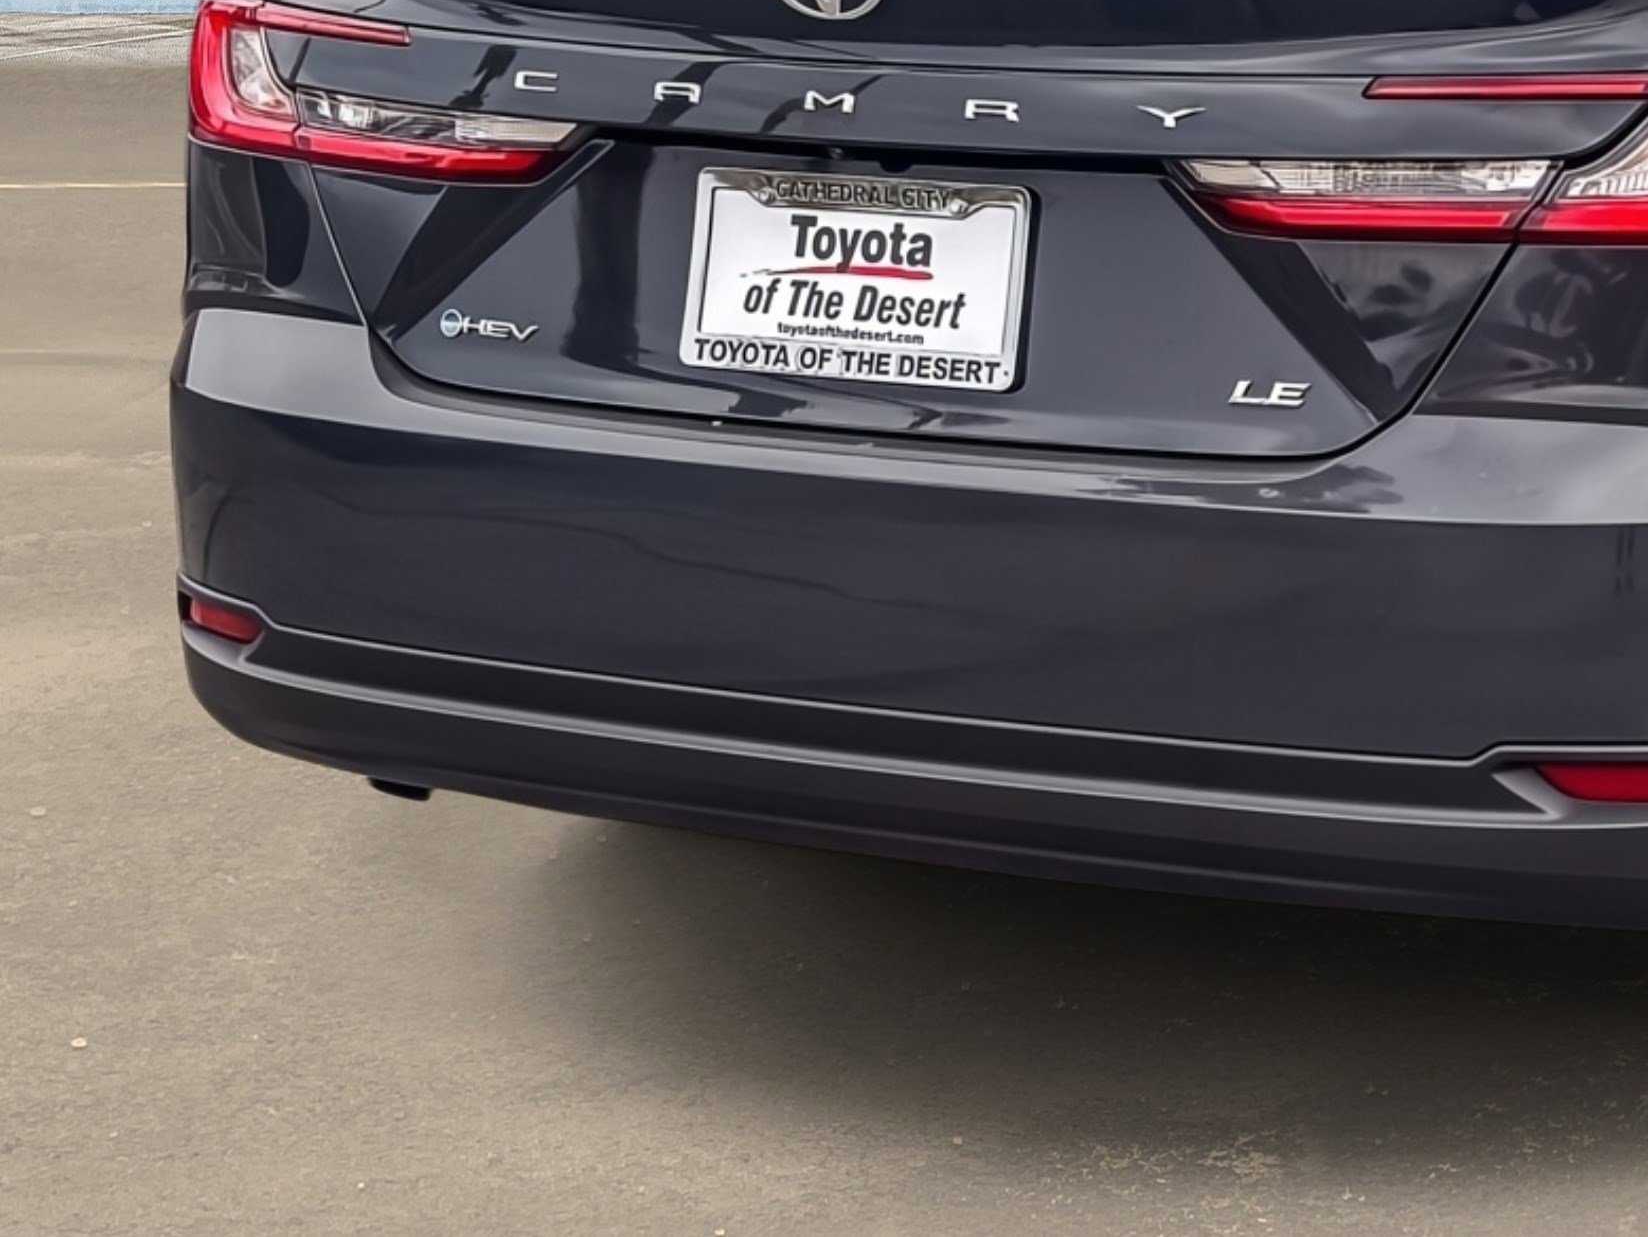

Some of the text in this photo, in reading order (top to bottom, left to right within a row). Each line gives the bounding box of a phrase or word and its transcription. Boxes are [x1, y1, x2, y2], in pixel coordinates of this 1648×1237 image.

[514, 70, 1207, 129] CAMRY
[775, 179, 951, 210] CATHEDRAL CITY
[790, 214, 934, 273] Toyota
[743, 278, 966, 329] of The Desert
[463, 316, 539, 340] HEV
[777, 322, 925, 346] toyotaofthedesert.com
[694, 339, 1001, 384] TOYOTA OF THE DESERT
[1228, 380, 1312, 406] LE
